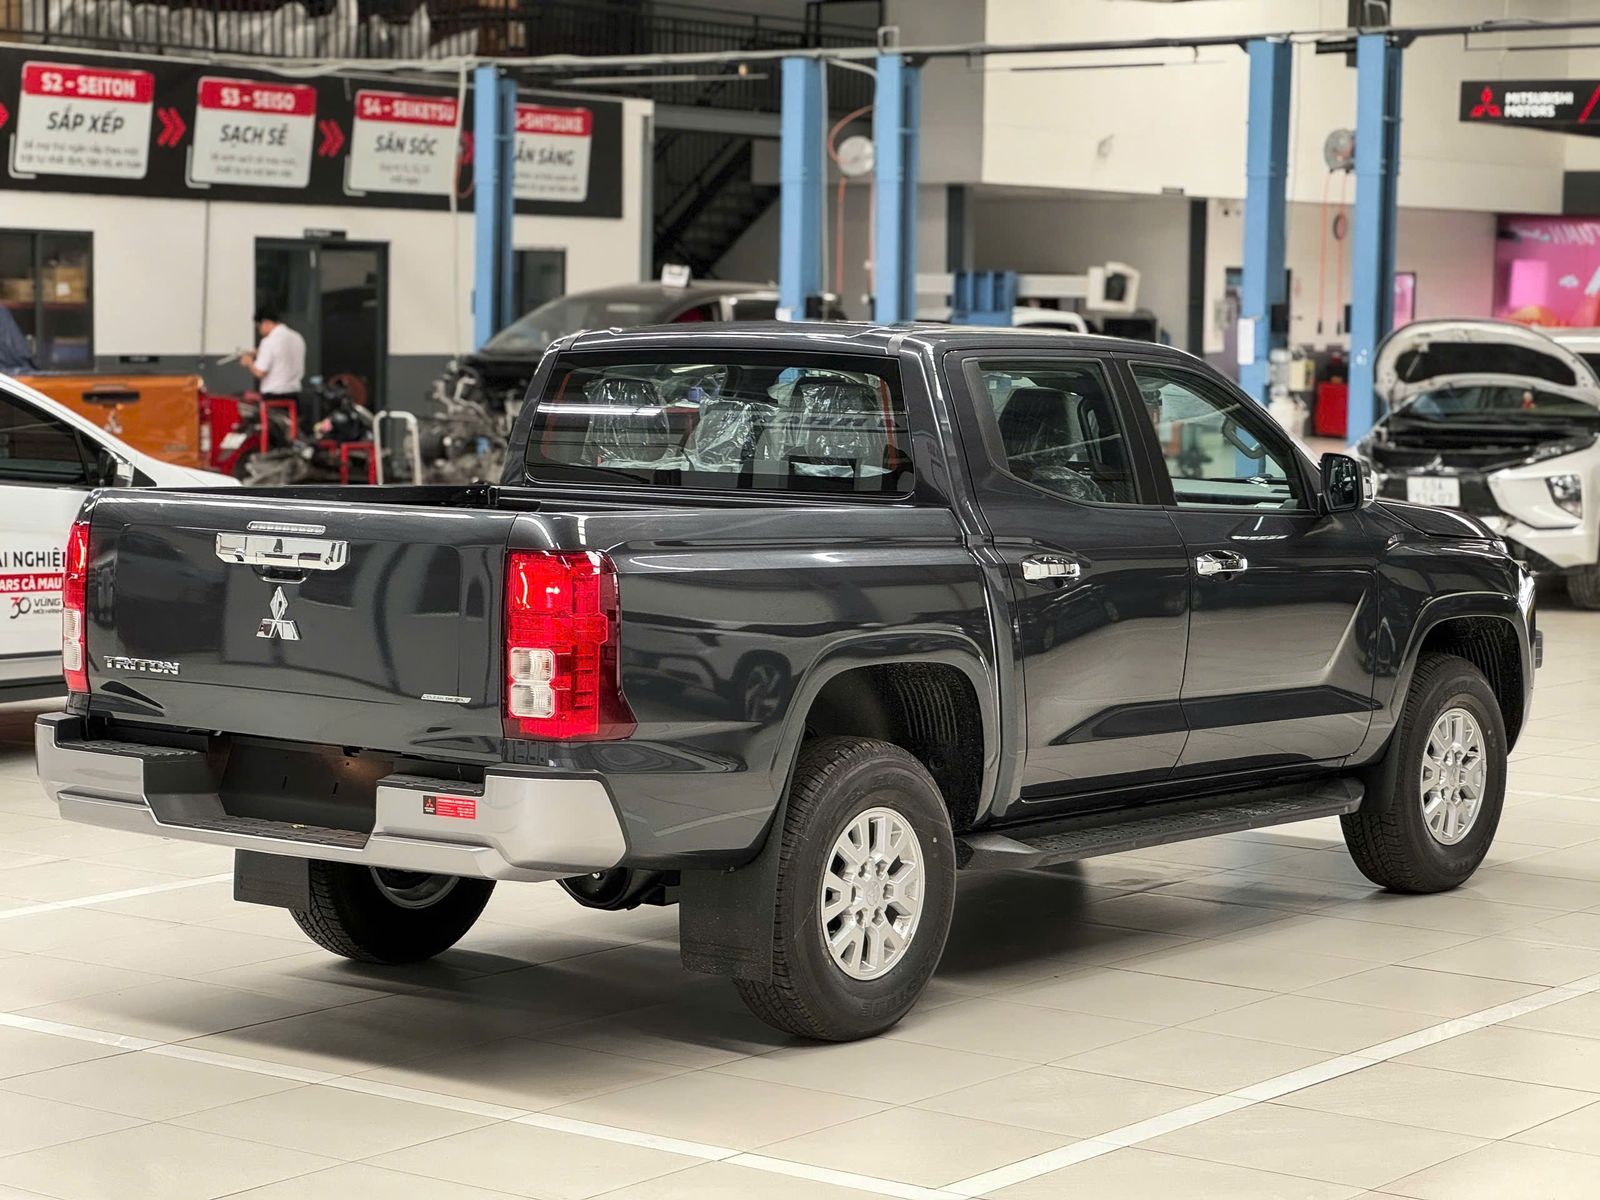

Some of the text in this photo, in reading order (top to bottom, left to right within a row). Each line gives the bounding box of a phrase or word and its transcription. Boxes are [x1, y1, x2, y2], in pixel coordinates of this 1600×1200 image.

[41, 72, 63, 92] S2
[77, 74, 136, 98] SEITON
[252, 90, 296, 111] SEISO
[21, 575, 36, 591] CÀ
[37, 577, 63, 590] MAU
[10, 596, 32, 619] 30
[103, 655, 181, 675] TRITON
